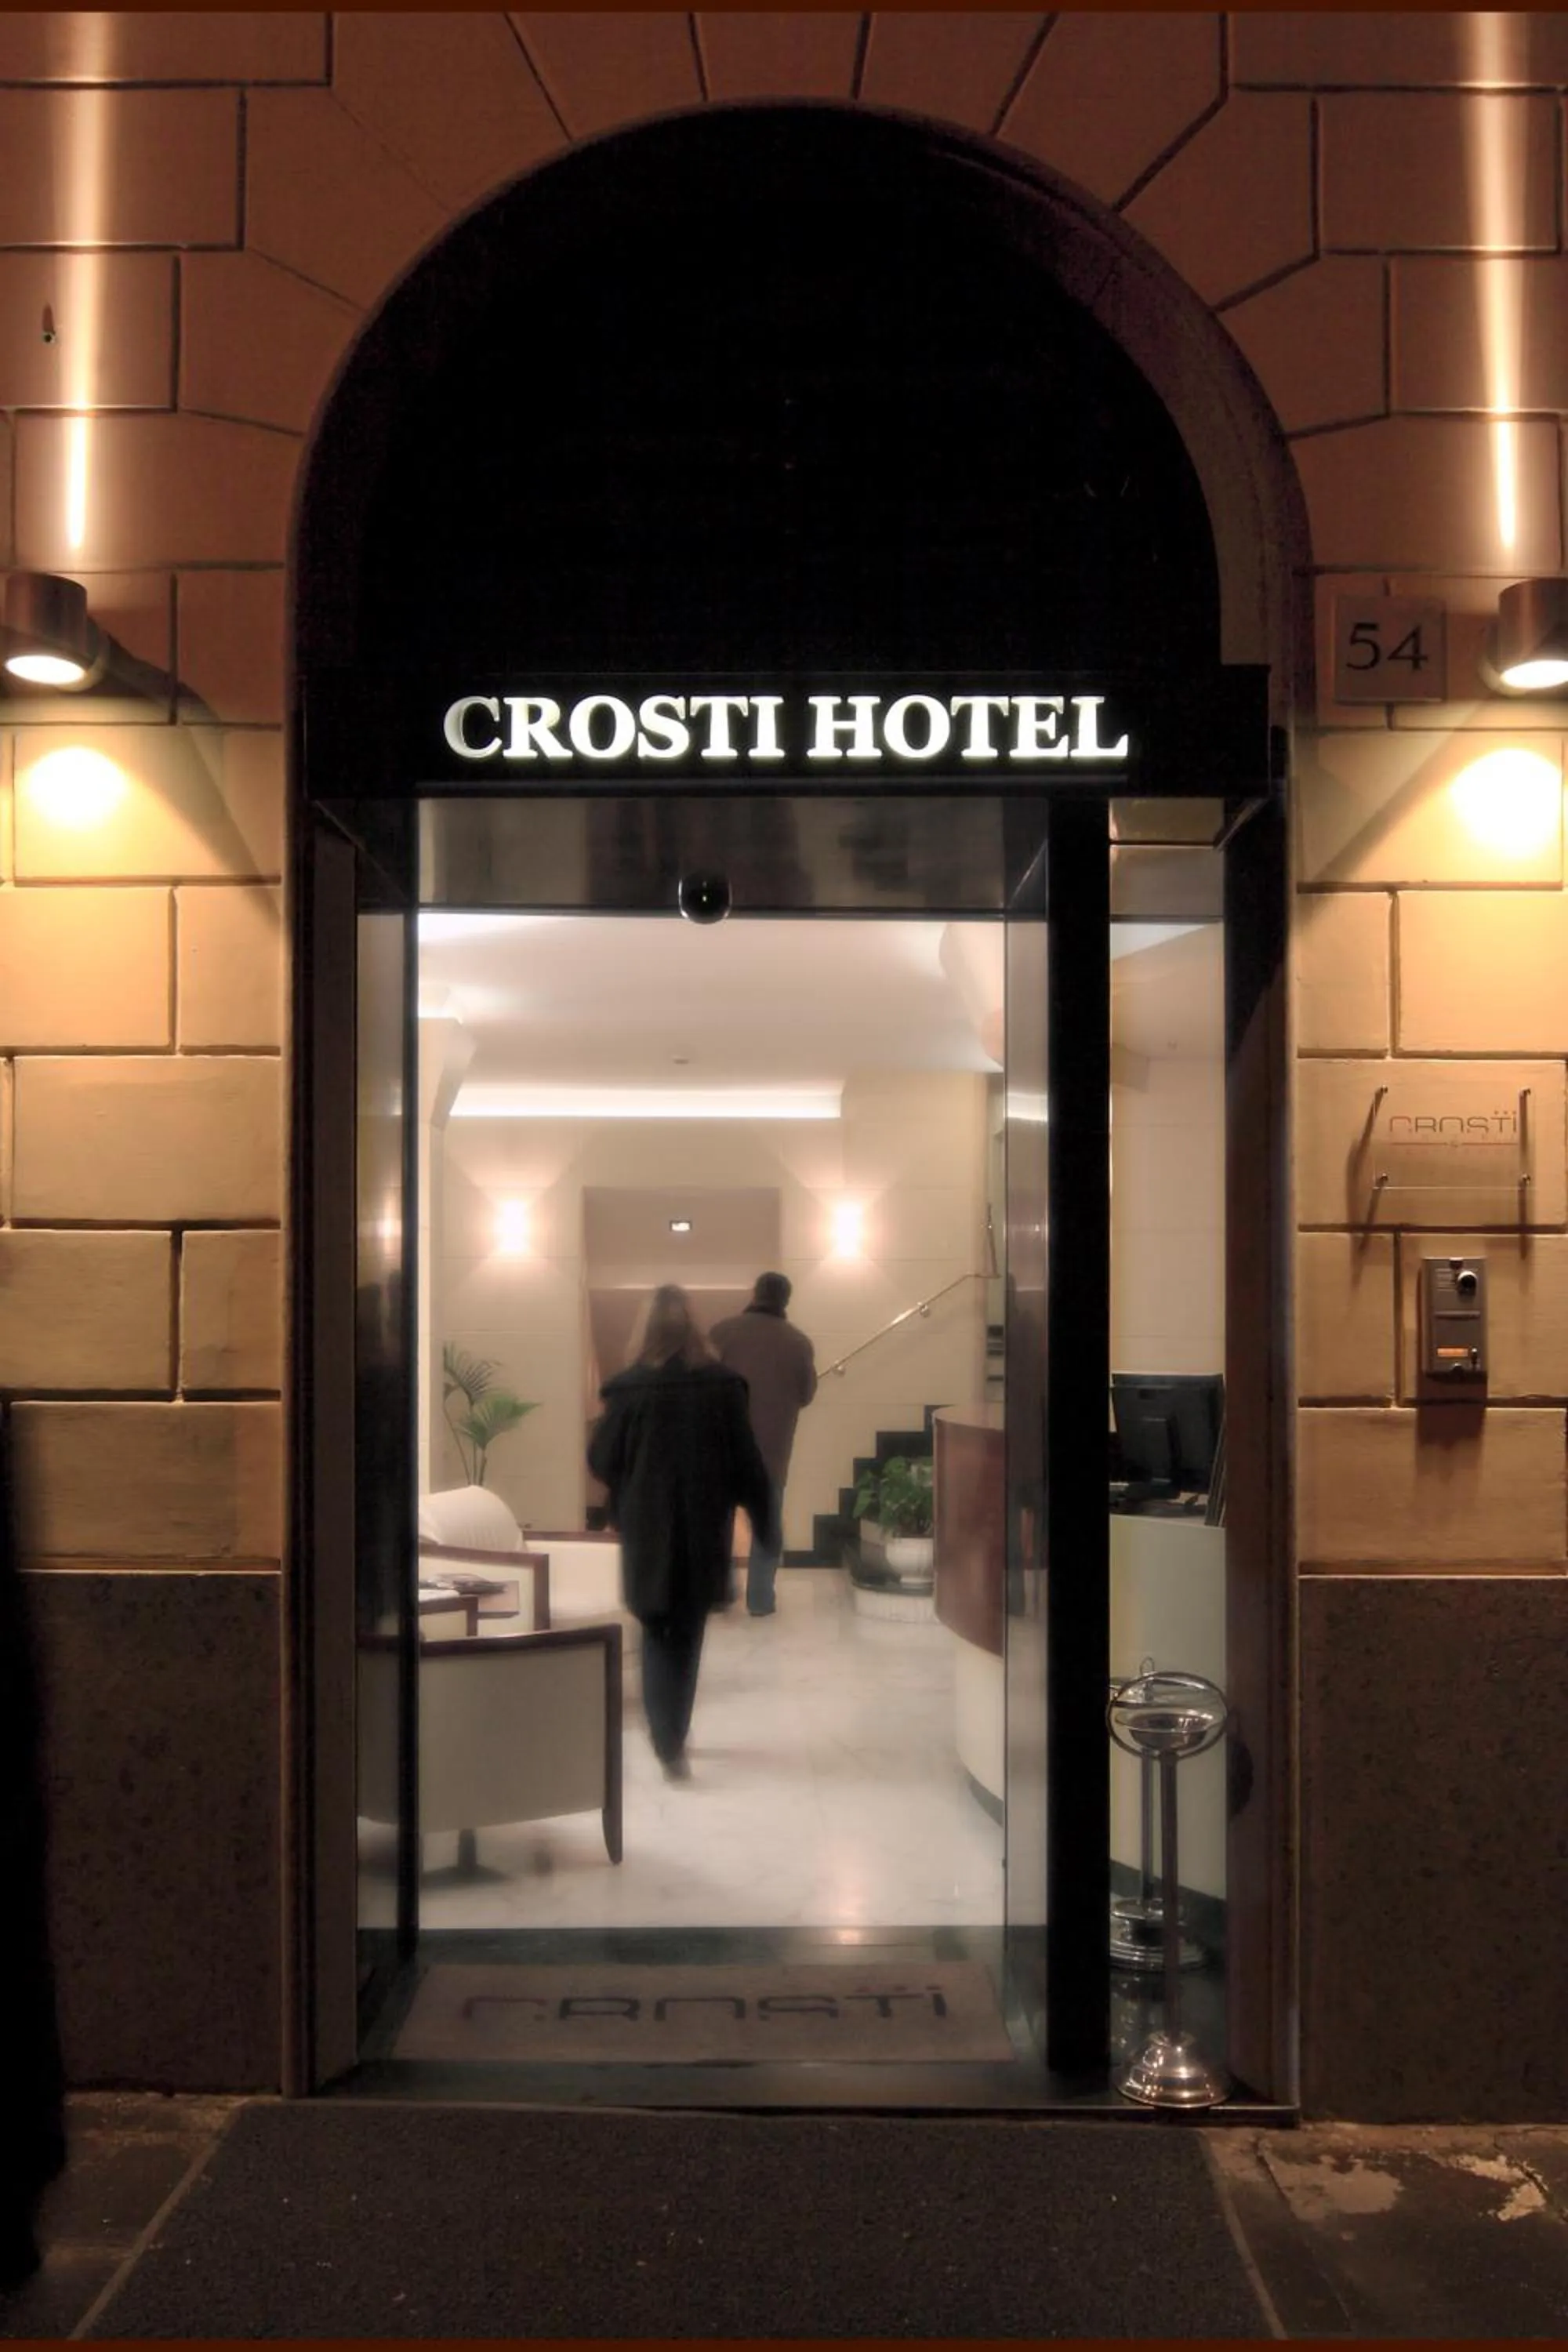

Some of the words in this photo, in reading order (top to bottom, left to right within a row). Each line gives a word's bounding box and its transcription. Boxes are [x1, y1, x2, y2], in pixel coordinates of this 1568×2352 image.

[1345, 622, 1428, 671] 54
[443, 695, 785, 760] CROSTI
[807, 695, 1130, 759] HOTEL
